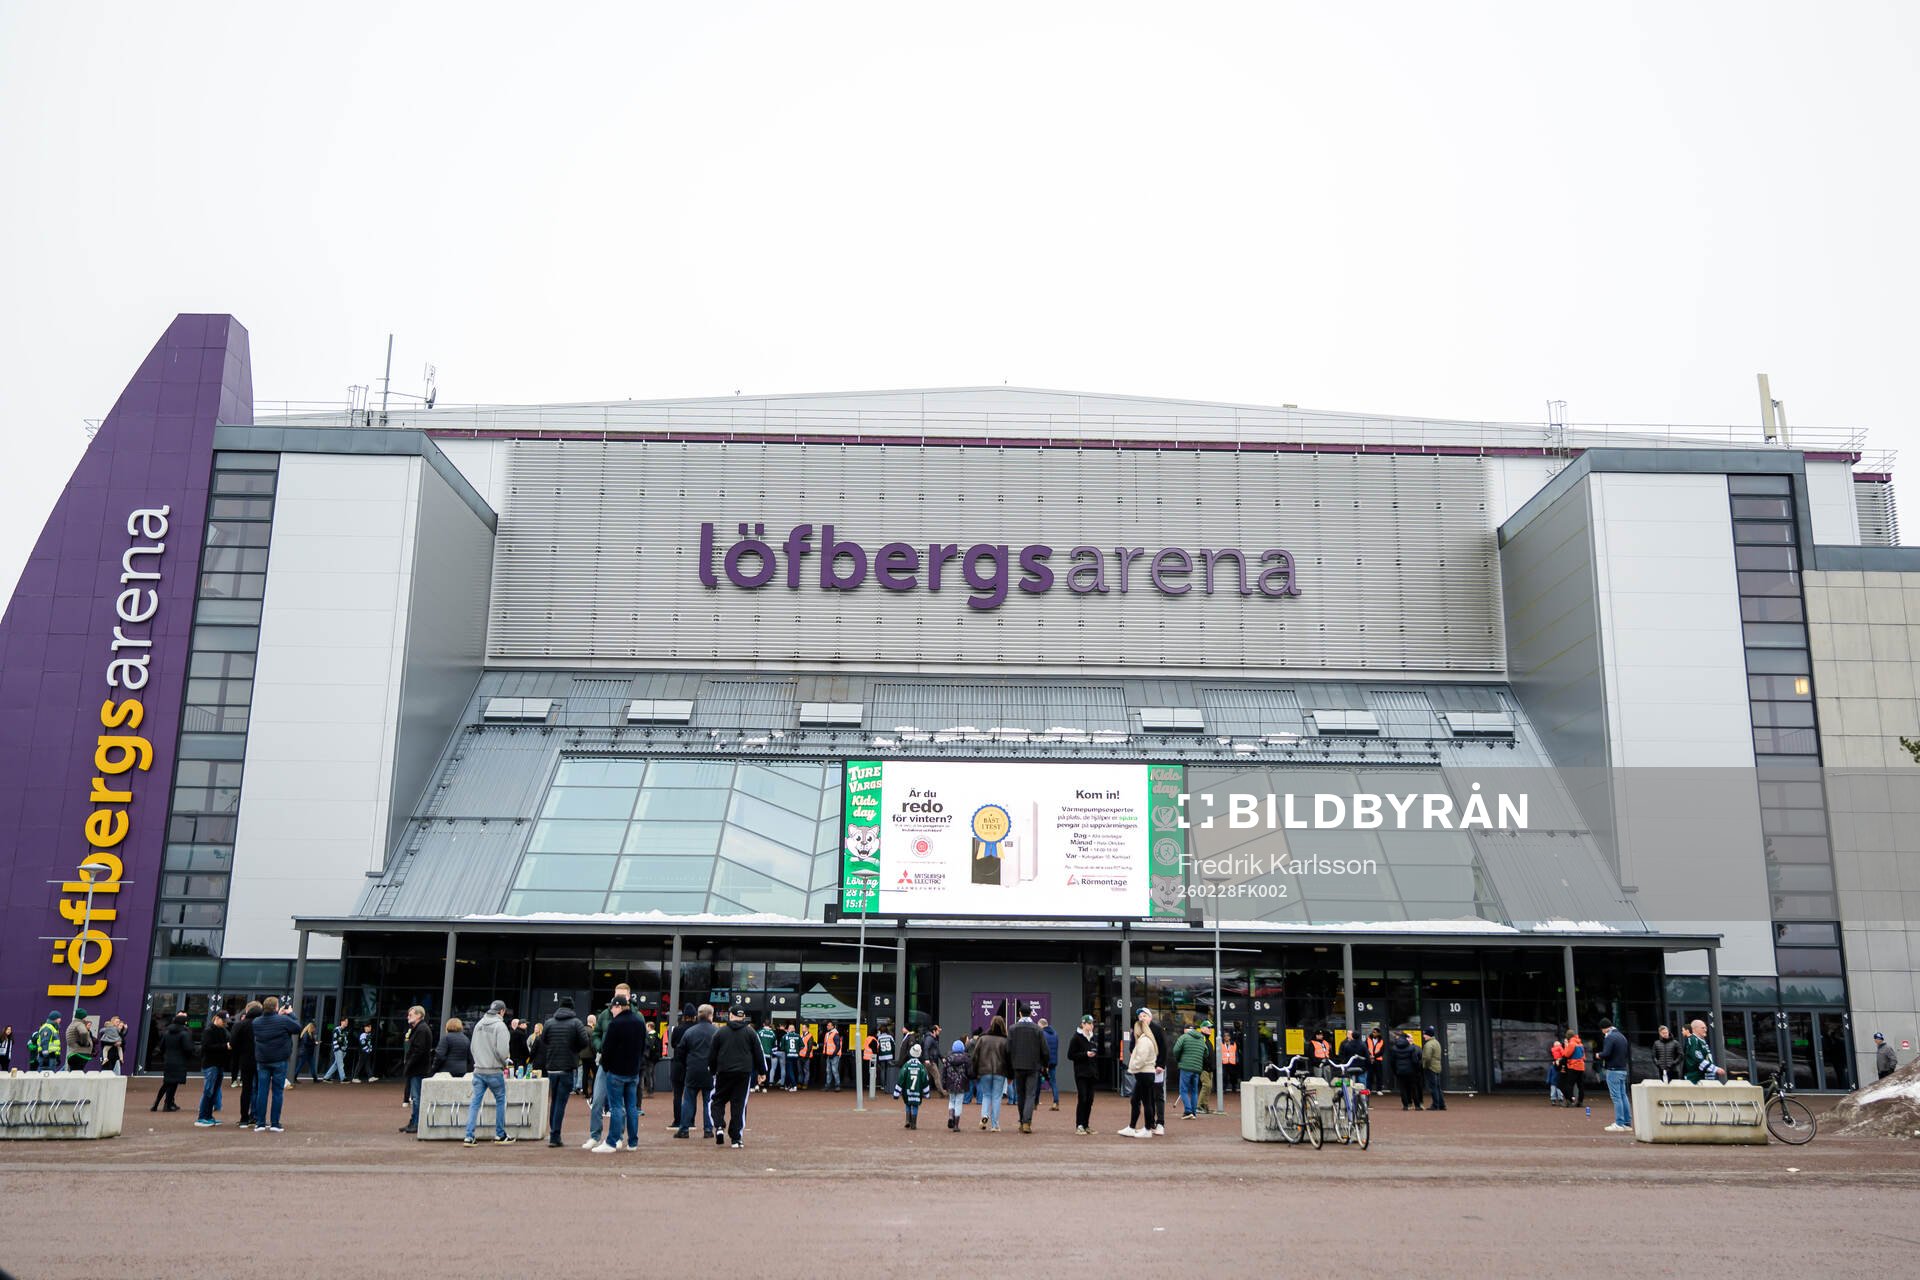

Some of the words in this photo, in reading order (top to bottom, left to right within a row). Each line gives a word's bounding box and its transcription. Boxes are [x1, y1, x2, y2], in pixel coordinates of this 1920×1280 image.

[1151, 768, 1182, 782] Kids
[849, 780, 882, 793] VARGS
[1152, 782, 1180, 798] day
[909, 788, 921, 798] Är
[924, 789, 937, 798] du
[1076, 789, 1103, 799] Kom
[1106, 790, 1120, 799] in!
[852, 794, 878, 806] Kids
[902, 799, 943, 813] redo
[853, 806, 876, 821] day
[892, 814, 906, 823] för
[909, 814, 953, 823] vintern?
[553, 992, 559, 1002] 1
[735, 994, 742, 1004] 3
[769, 995, 777, 1005] 4
[874, 996, 881, 1006] 5
[1116, 999, 1123, 1009] 6
[1220, 1000, 1227, 1010] 7
[1254, 1001, 1261, 1010] 8
[1357, 1002, 1364, 1011] 9
[1450, 1003, 1461, 1012] 10
[790, 1039, 796, 1049] 6
[880, 1042, 892, 1052] 59
[910, 1075, 918, 1091] 7
